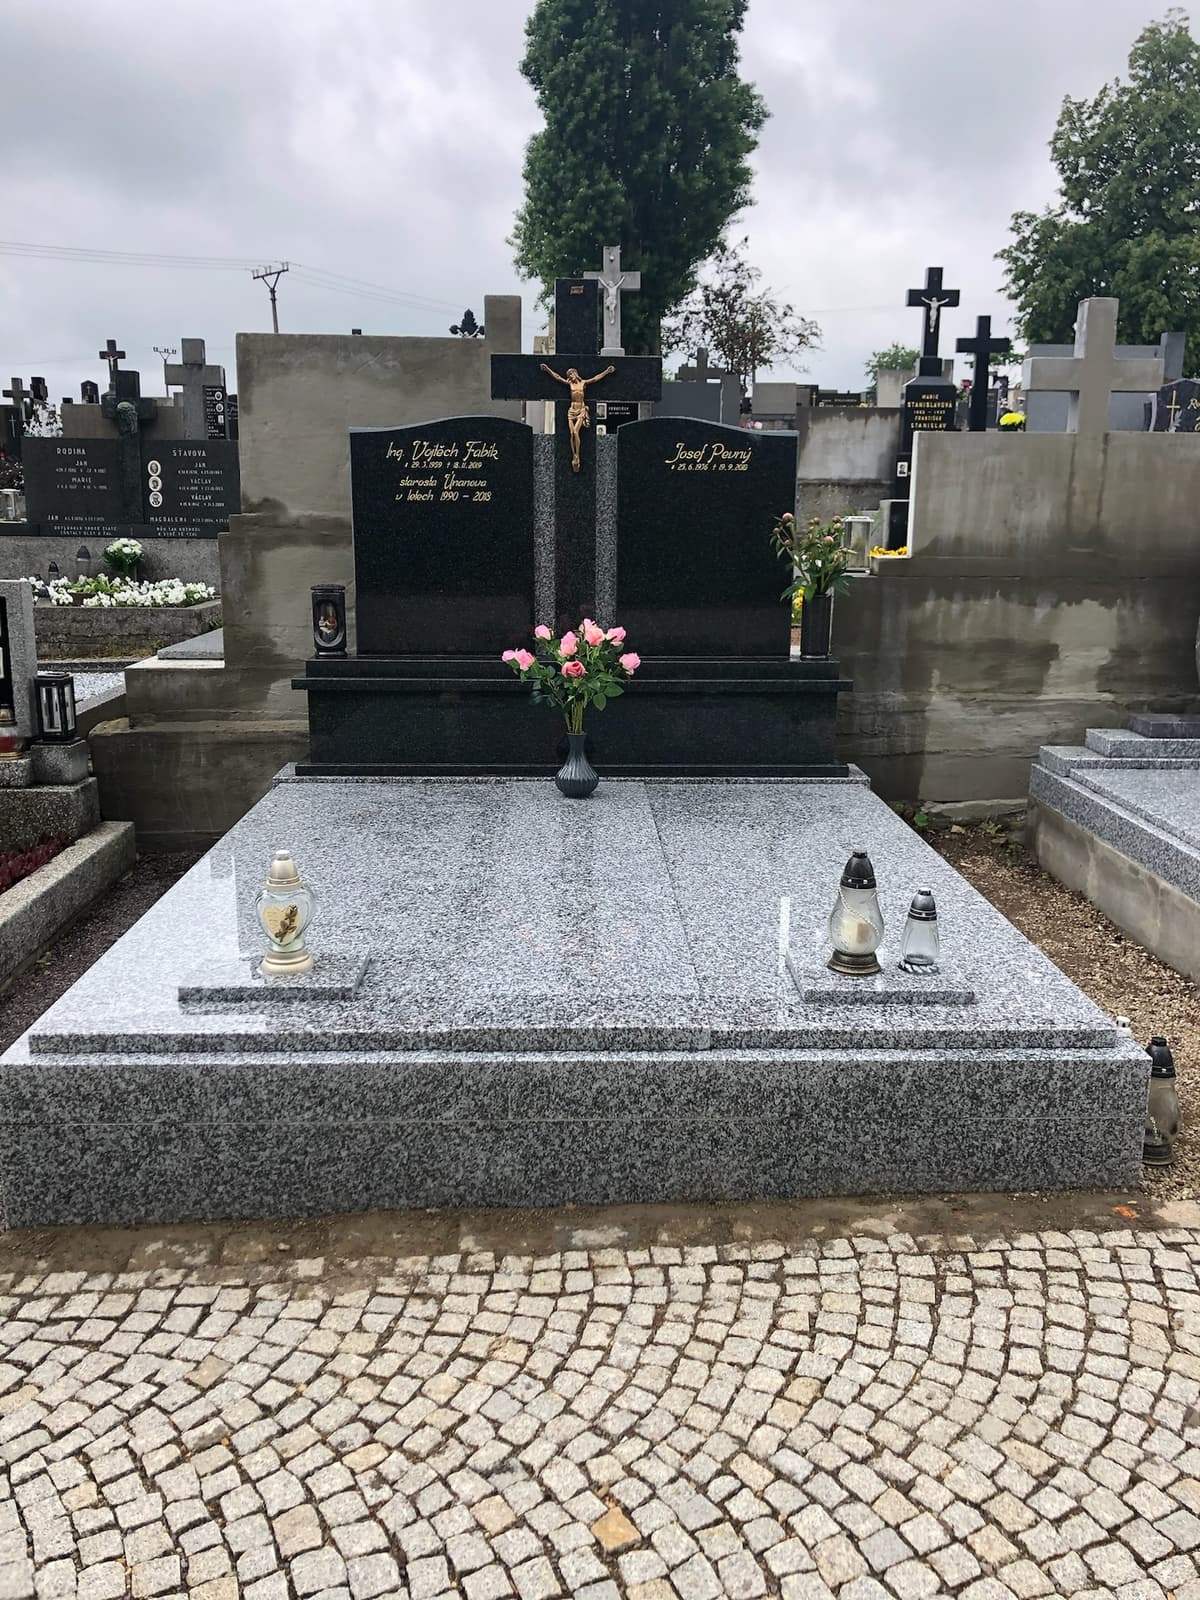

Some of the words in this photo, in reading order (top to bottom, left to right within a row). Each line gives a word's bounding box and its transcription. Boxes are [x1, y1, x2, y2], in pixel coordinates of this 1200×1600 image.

[56, 447, 86, 455] RODINA
[386, 441, 405, 461] Ing.
[412, 440, 459, 461] Vojtěch
[665, 442, 709, 463] Josef
[707, 443, 752, 464] Pevný
[400, 475, 437, 487] starosta
[444, 471, 487, 489] Únanova
[407, 489, 434, 501] letech
[440, 491, 459, 501] 1990
[472, 491, 492, 501] 2018
